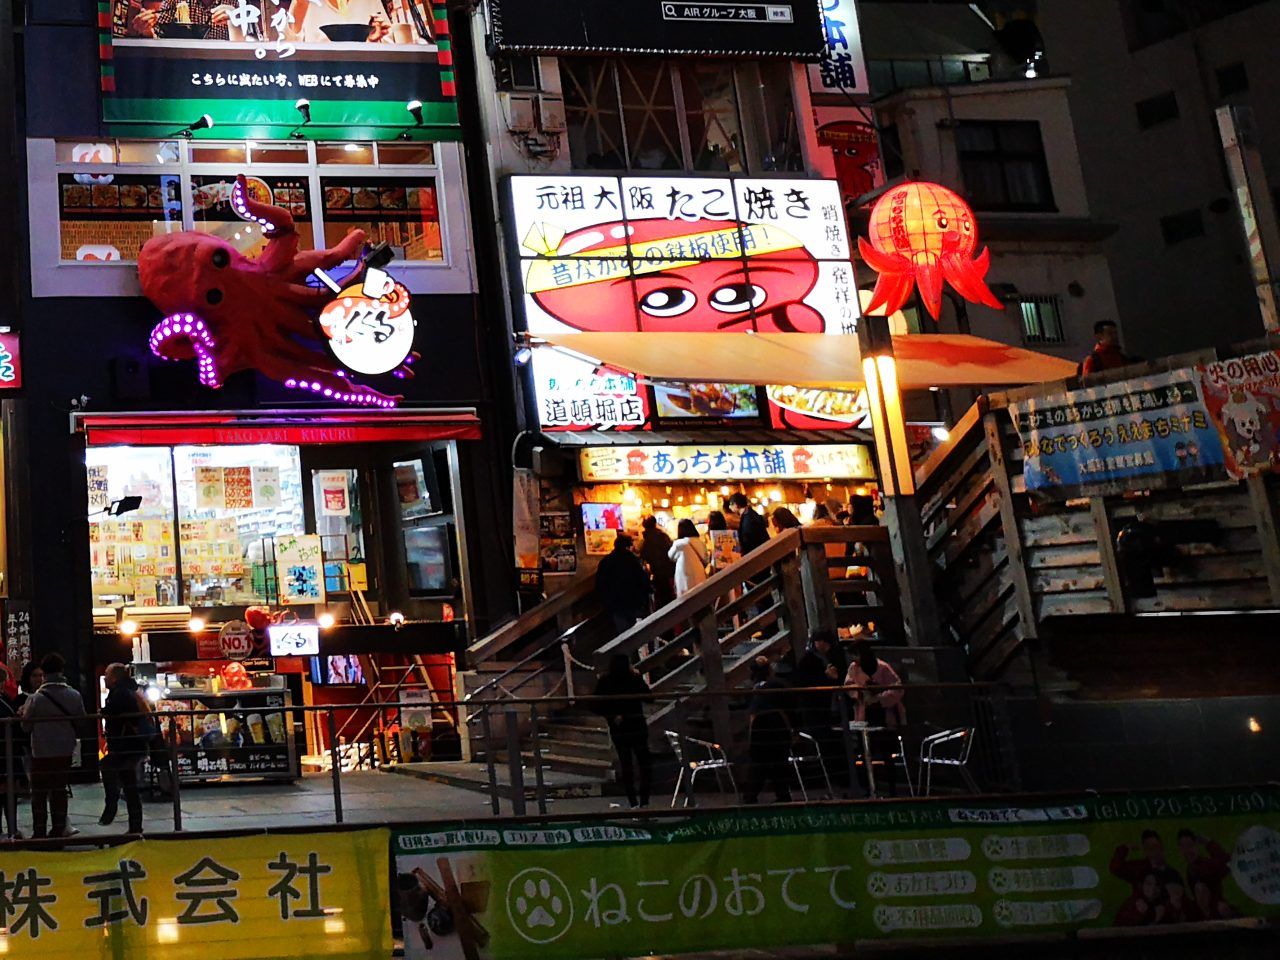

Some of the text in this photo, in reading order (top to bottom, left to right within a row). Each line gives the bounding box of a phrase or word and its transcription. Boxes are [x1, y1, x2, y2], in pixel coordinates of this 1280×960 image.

[684, 8, 701, 17] AIR
[535, 185, 811, 220] 元祖大阪たこ焼き
[544, 398, 641, 423] 道頓堀店
[222, 637, 253, 650] NO.1
[584, 865, 856, 927] ねこのおてて
